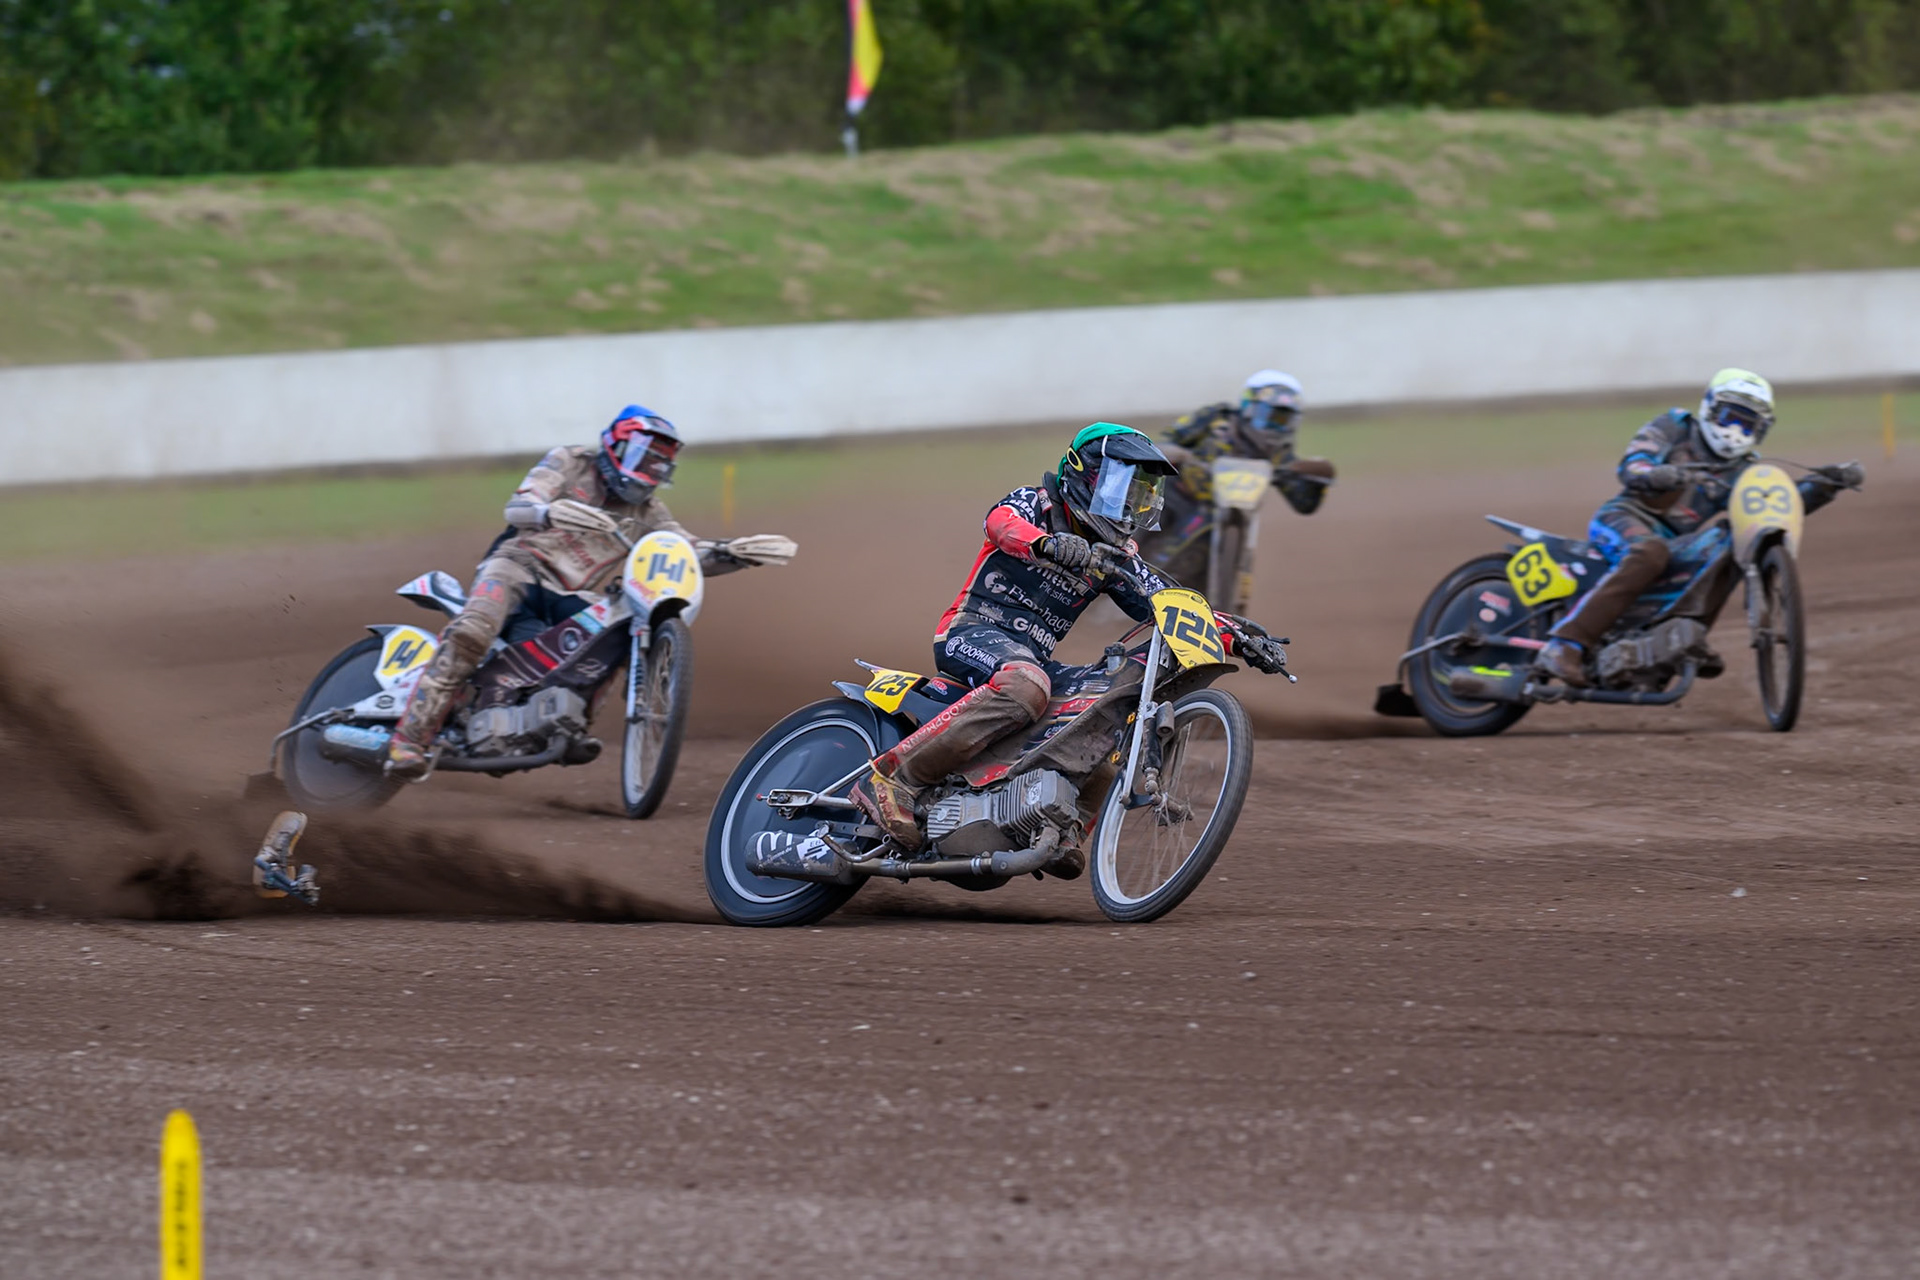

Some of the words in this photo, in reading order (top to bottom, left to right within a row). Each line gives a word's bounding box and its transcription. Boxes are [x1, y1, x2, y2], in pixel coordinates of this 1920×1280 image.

[1741, 485, 1791, 515] 63
[1514, 550, 1552, 598] 63
[1162, 605, 1224, 663] 125
